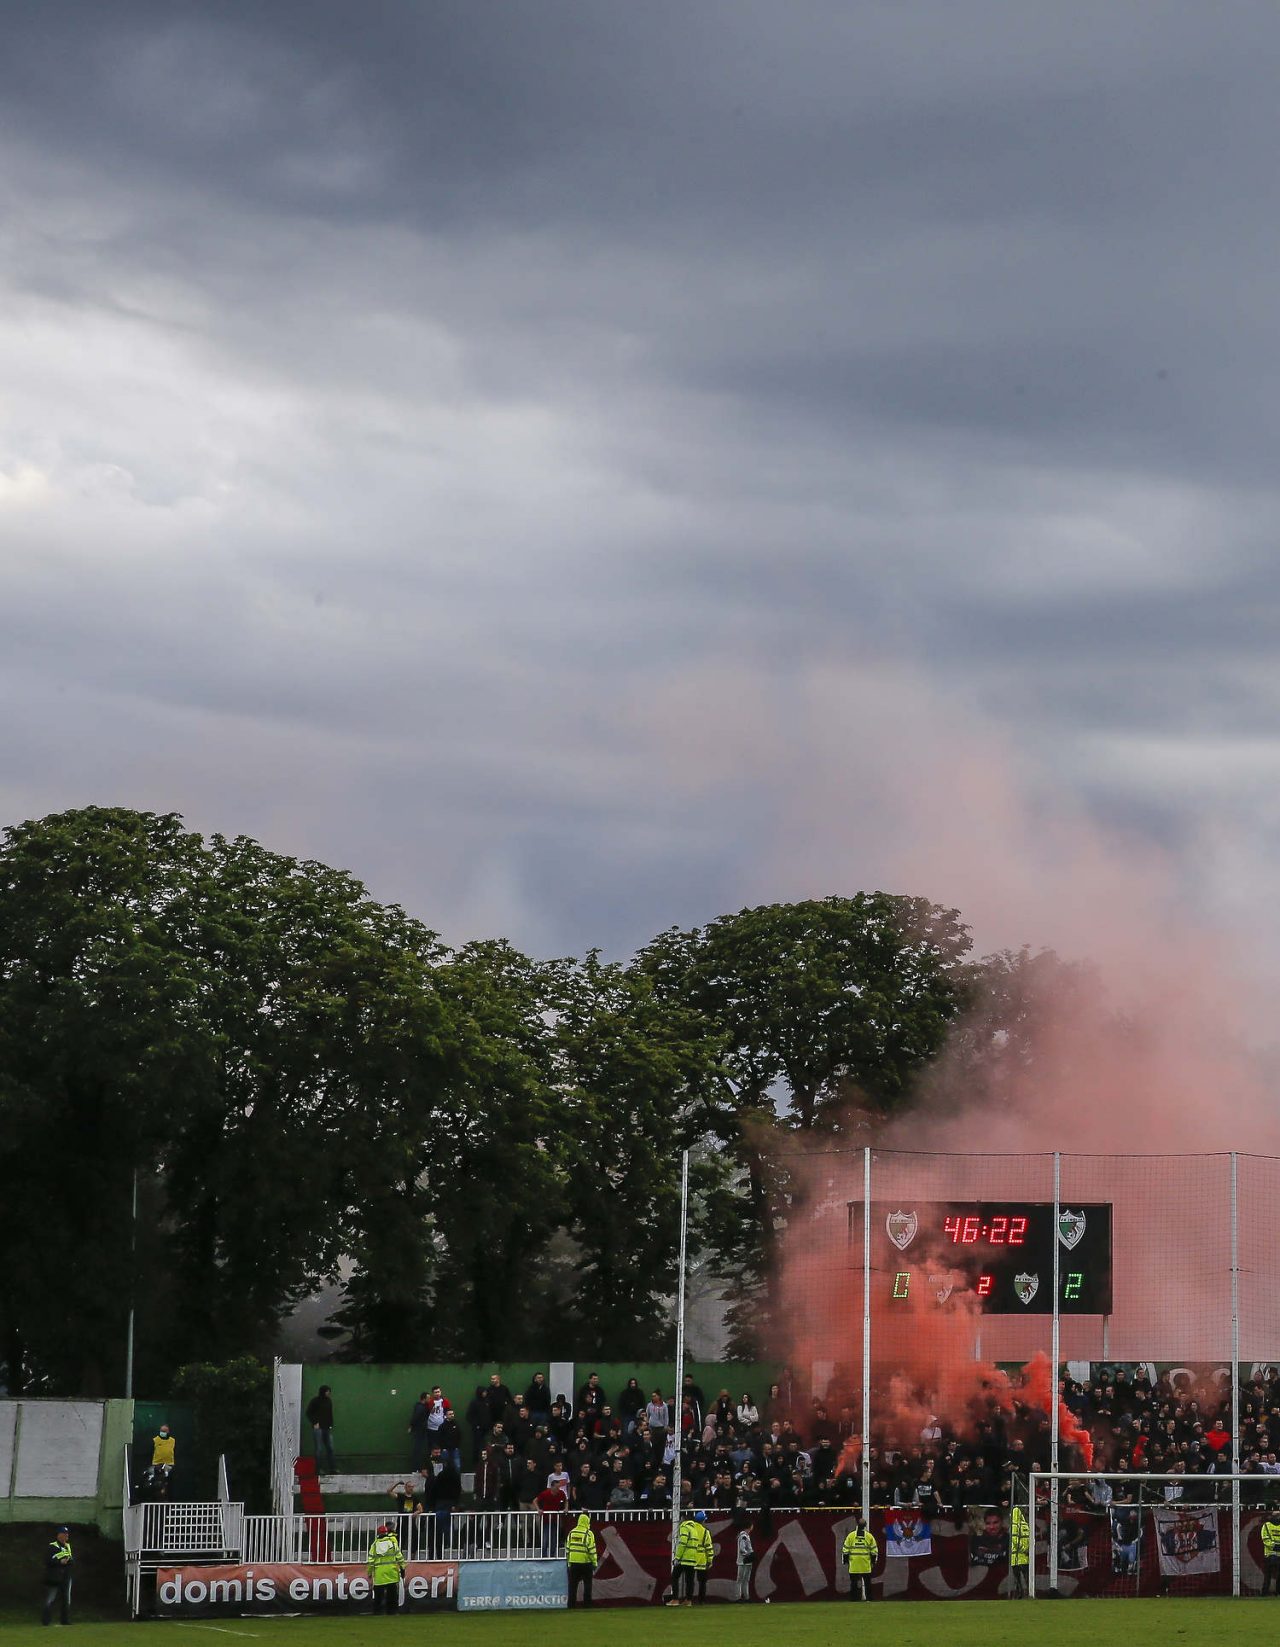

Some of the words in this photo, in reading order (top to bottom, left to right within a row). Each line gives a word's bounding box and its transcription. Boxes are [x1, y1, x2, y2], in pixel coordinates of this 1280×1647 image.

[944, 1217, 1029, 1243] 46:22
[893, 1272, 911, 1298] 0
[977, 1276, 991, 1295] 2
[1065, 1273, 1083, 1299] 2
[159, 1571, 276, 1604] domis
[289, 1568, 455, 1607] entejeri
